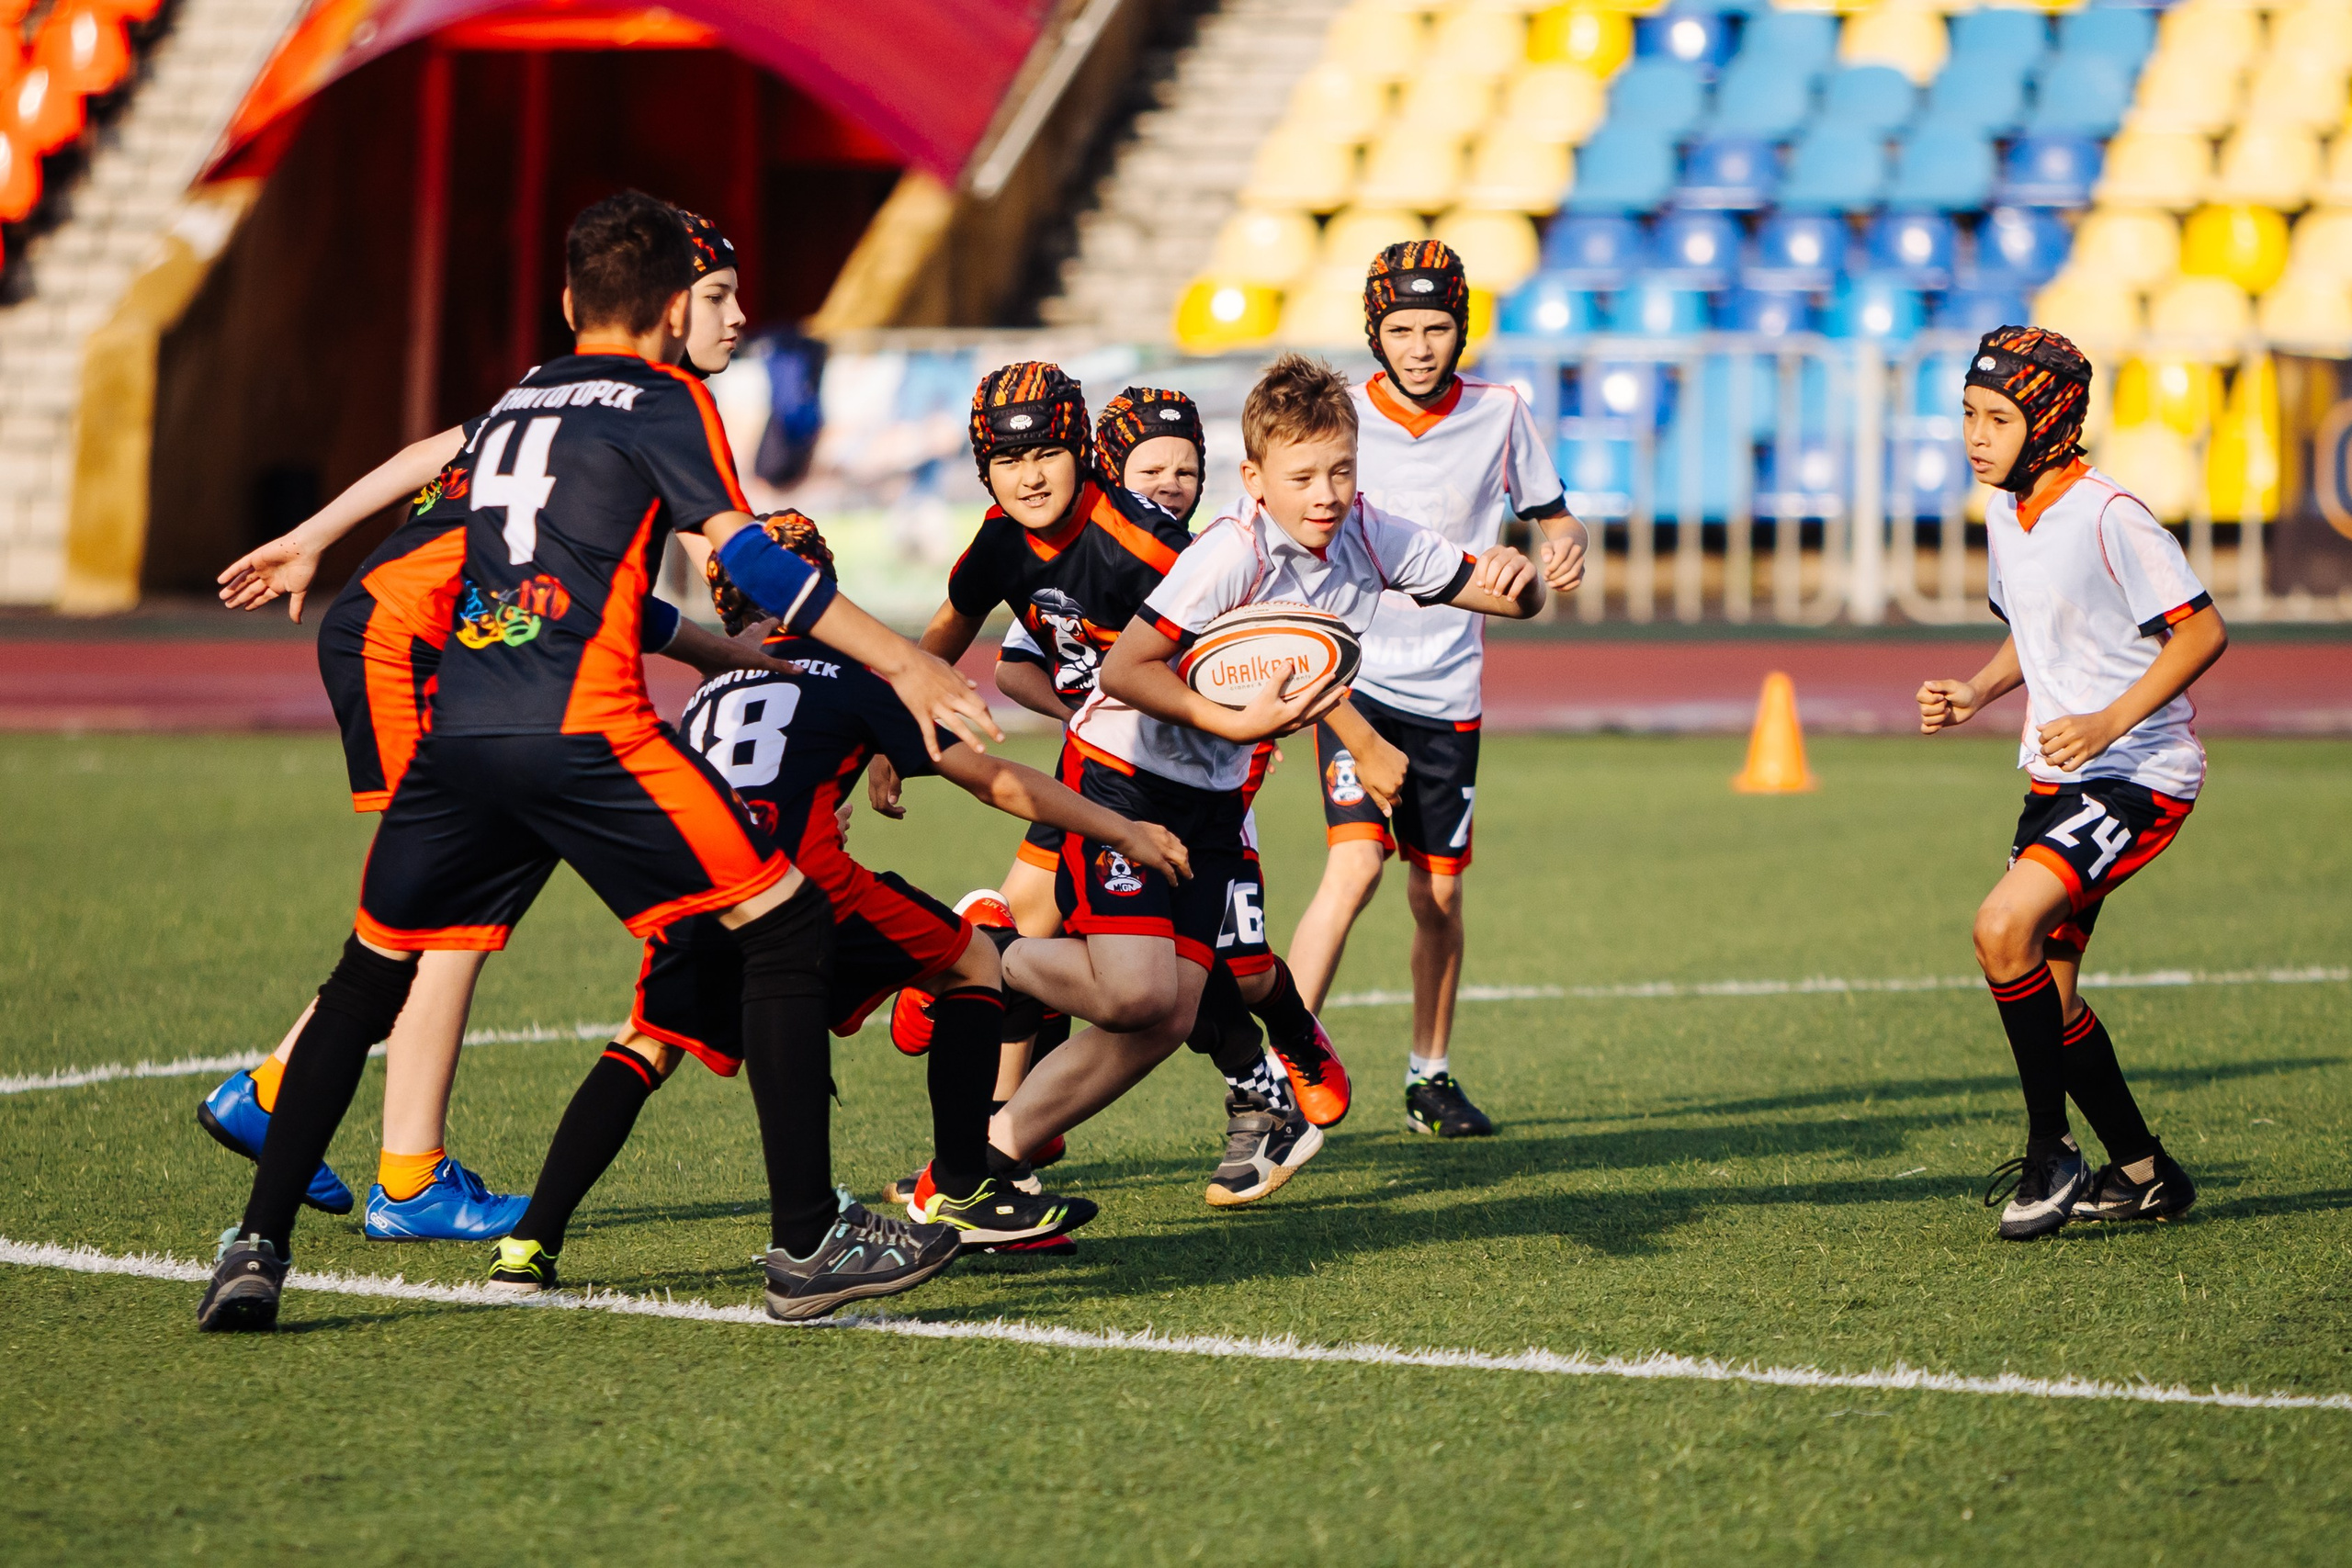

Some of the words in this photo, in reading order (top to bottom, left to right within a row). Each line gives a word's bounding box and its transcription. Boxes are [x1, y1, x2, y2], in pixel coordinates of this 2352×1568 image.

[490, 379, 645, 417] ГНИТОГОРСК
[469, 416, 561, 565] 4
[690, 682, 801, 789] 18
[1449, 785, 1476, 848] 7
[2045, 793, 2132, 880] 24
[370, 1212, 388, 1229] GSD
